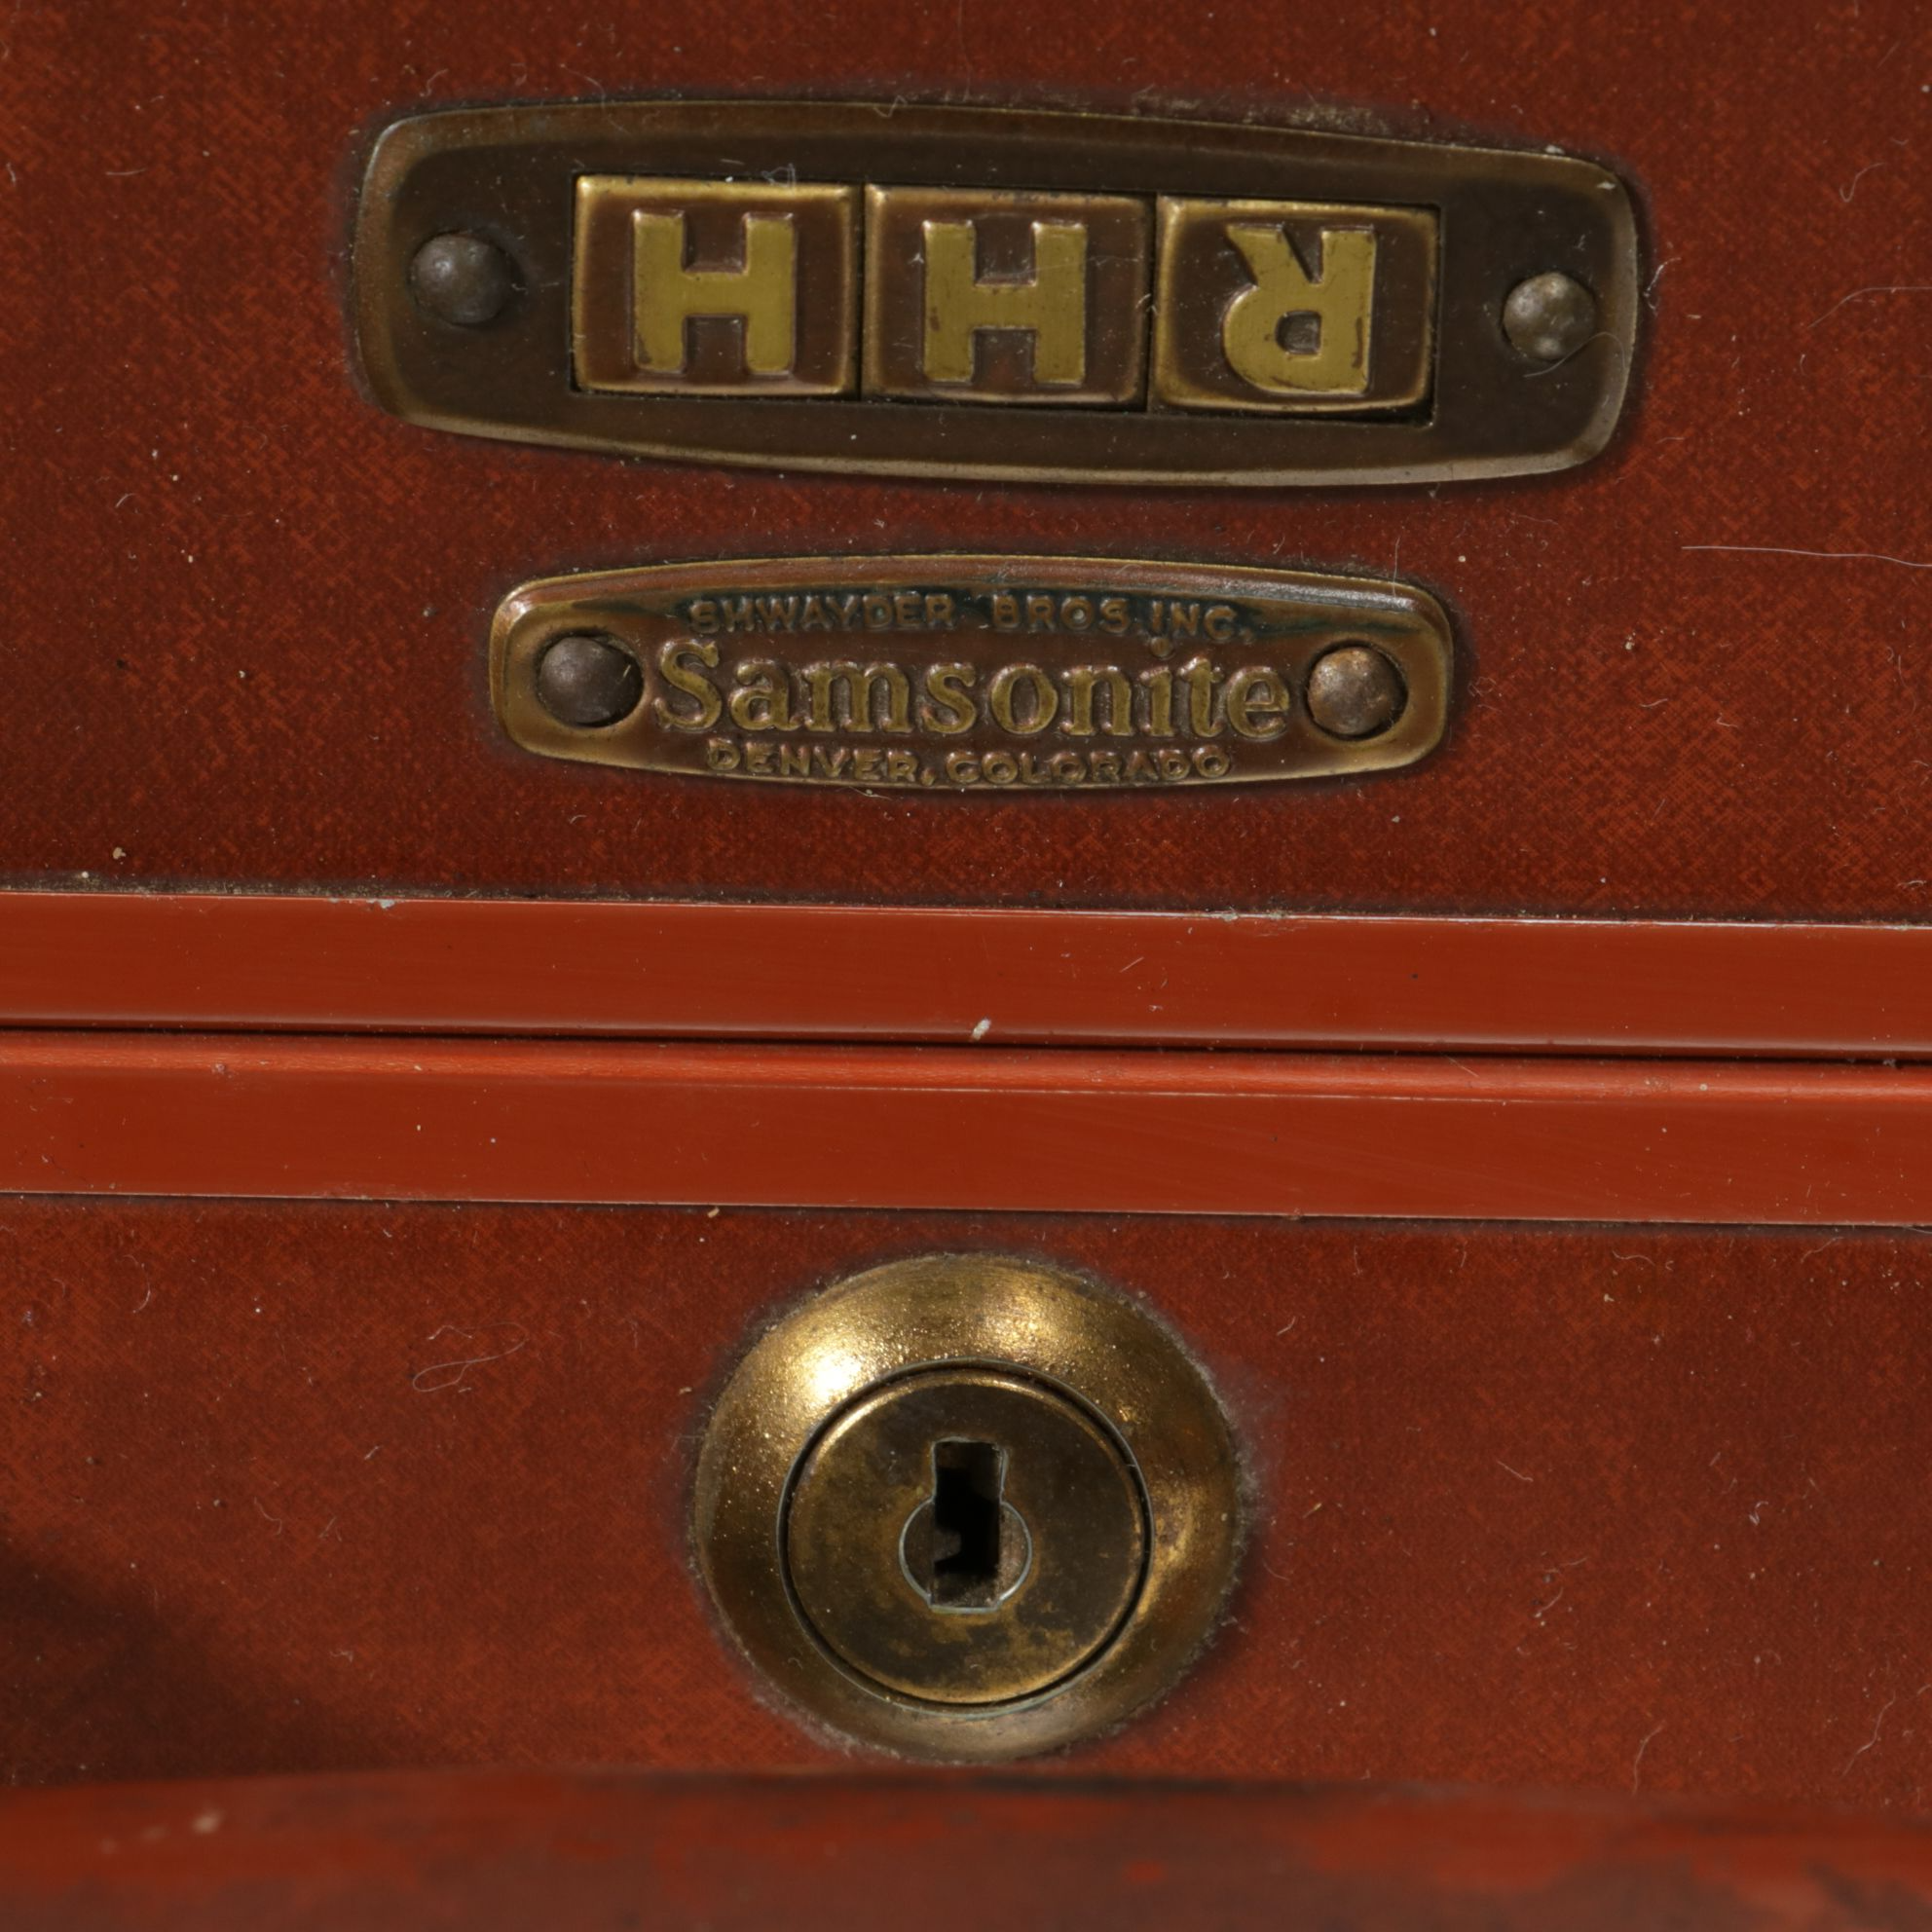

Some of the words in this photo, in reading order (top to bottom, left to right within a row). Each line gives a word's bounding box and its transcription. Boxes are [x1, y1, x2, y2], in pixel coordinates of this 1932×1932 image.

[688, 592, 956, 633] SHWAYDER
[651, 636, 1290, 740] Samsonite
[946, 744, 1230, 784] COLORADO
